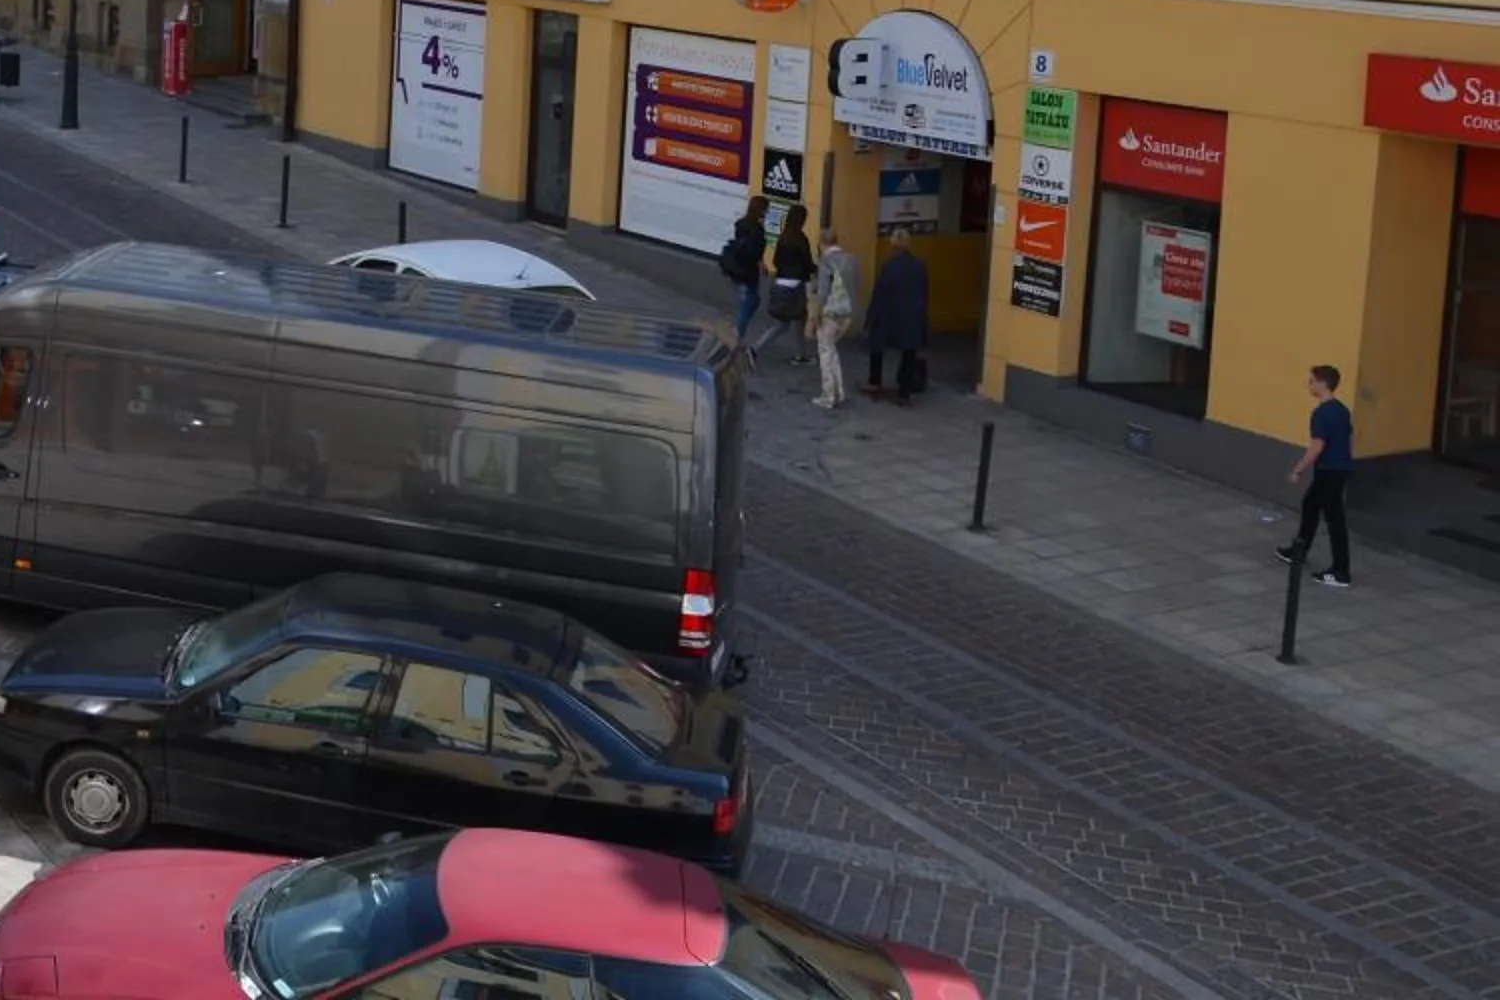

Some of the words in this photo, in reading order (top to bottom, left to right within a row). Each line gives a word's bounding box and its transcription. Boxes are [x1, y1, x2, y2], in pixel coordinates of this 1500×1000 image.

[421, 34, 460, 80] 4%
[1035, 54, 1048, 73] 8
[1142, 133, 1222, 164] Santander
